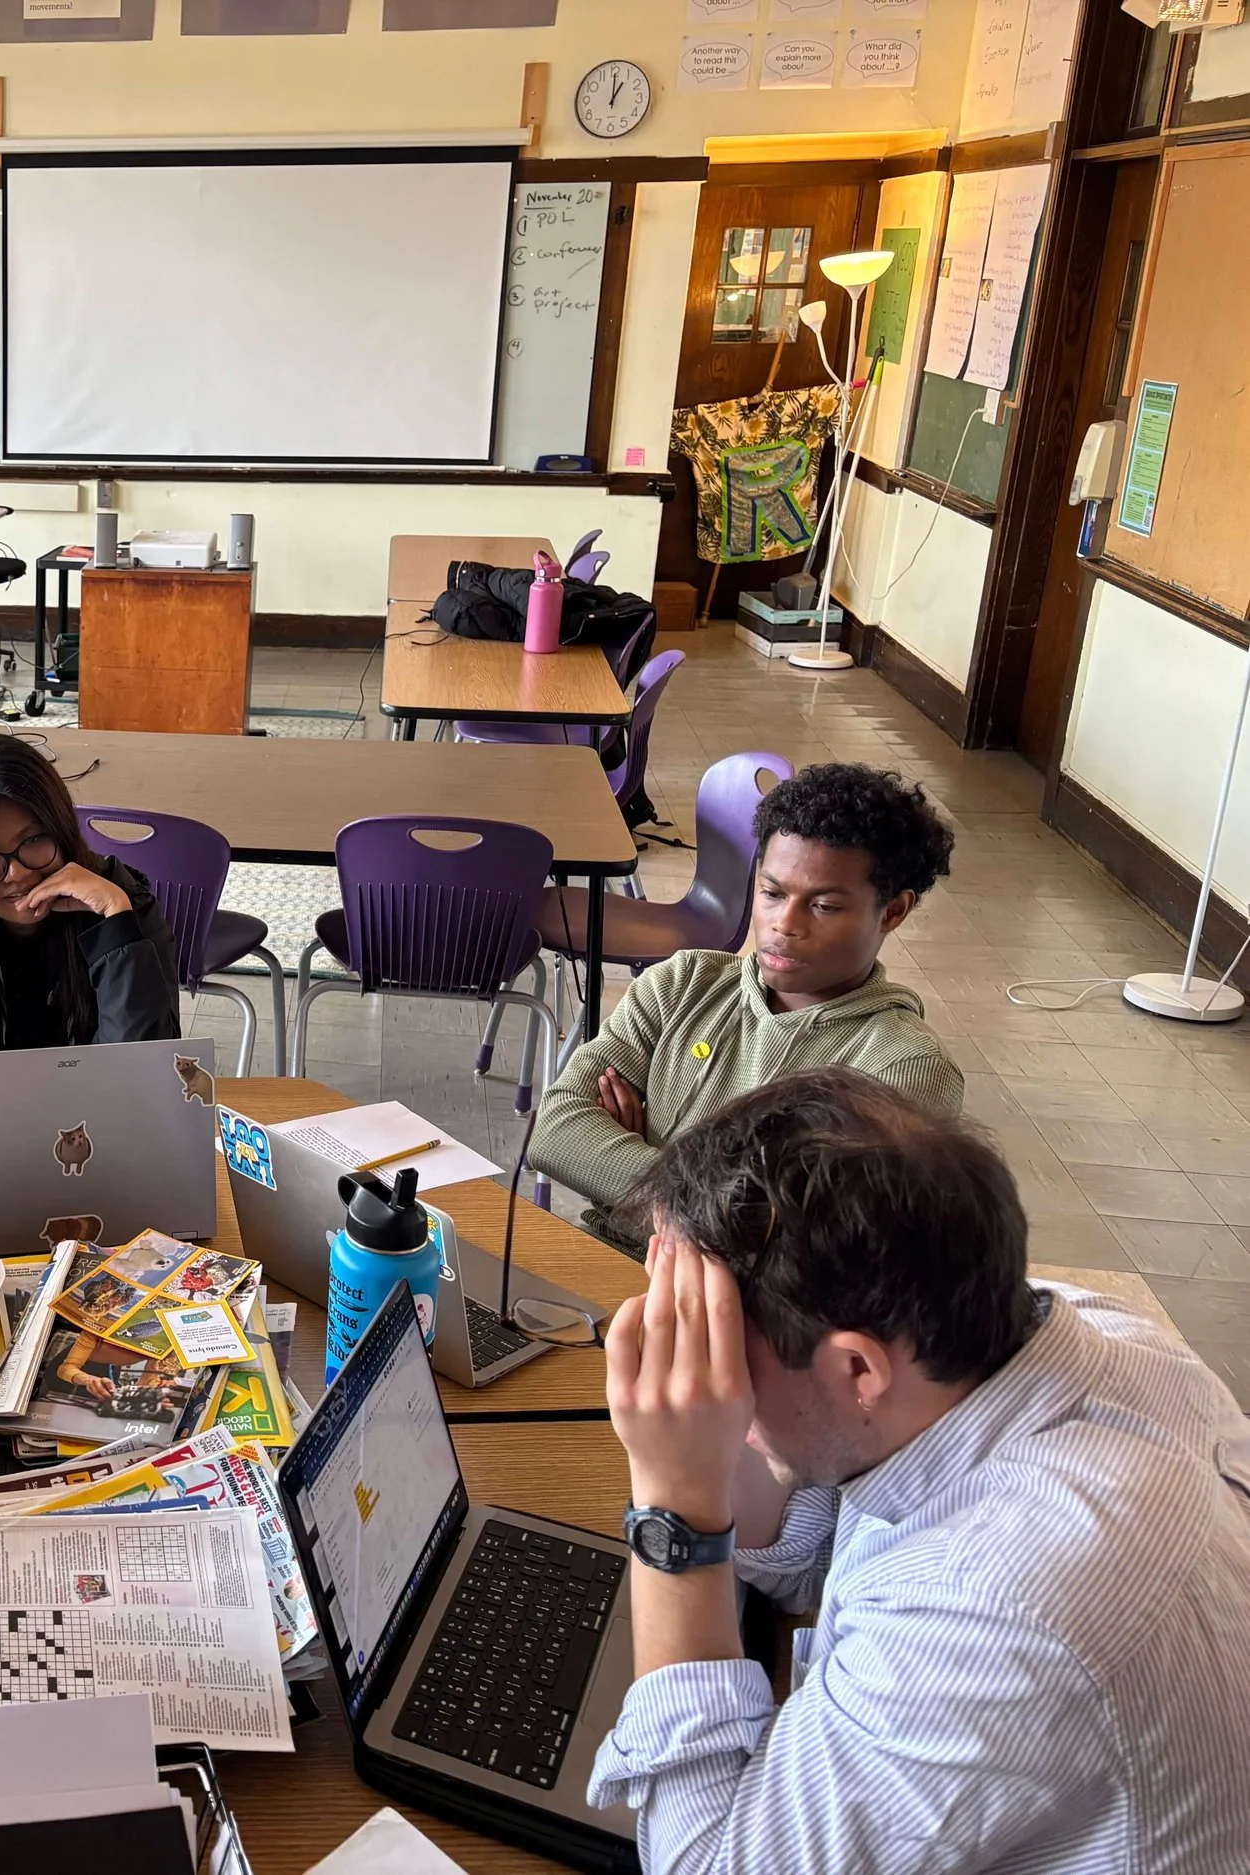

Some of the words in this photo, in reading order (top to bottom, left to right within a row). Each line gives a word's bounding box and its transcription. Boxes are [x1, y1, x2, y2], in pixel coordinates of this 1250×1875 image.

[30, 2, 73, 11] movements?
[526, 192, 572, 206] November
[534, 298, 595, 318] project
[721, 438, 813, 562] R
[57, 1060, 80, 1068] acer
[124, 1423, 159, 1434] intel
[218, 1458, 229, 1472] FOR
[226, 1472, 242, 1498] YOUNG
[228, 1456, 248, 1482] NEWS
[241, 1482, 248, 1491] &
[247, 1468, 264, 1499] WORLD'S
[260, 1498, 272, 1513] BEST
[274, 1595, 284, 1611] Making
